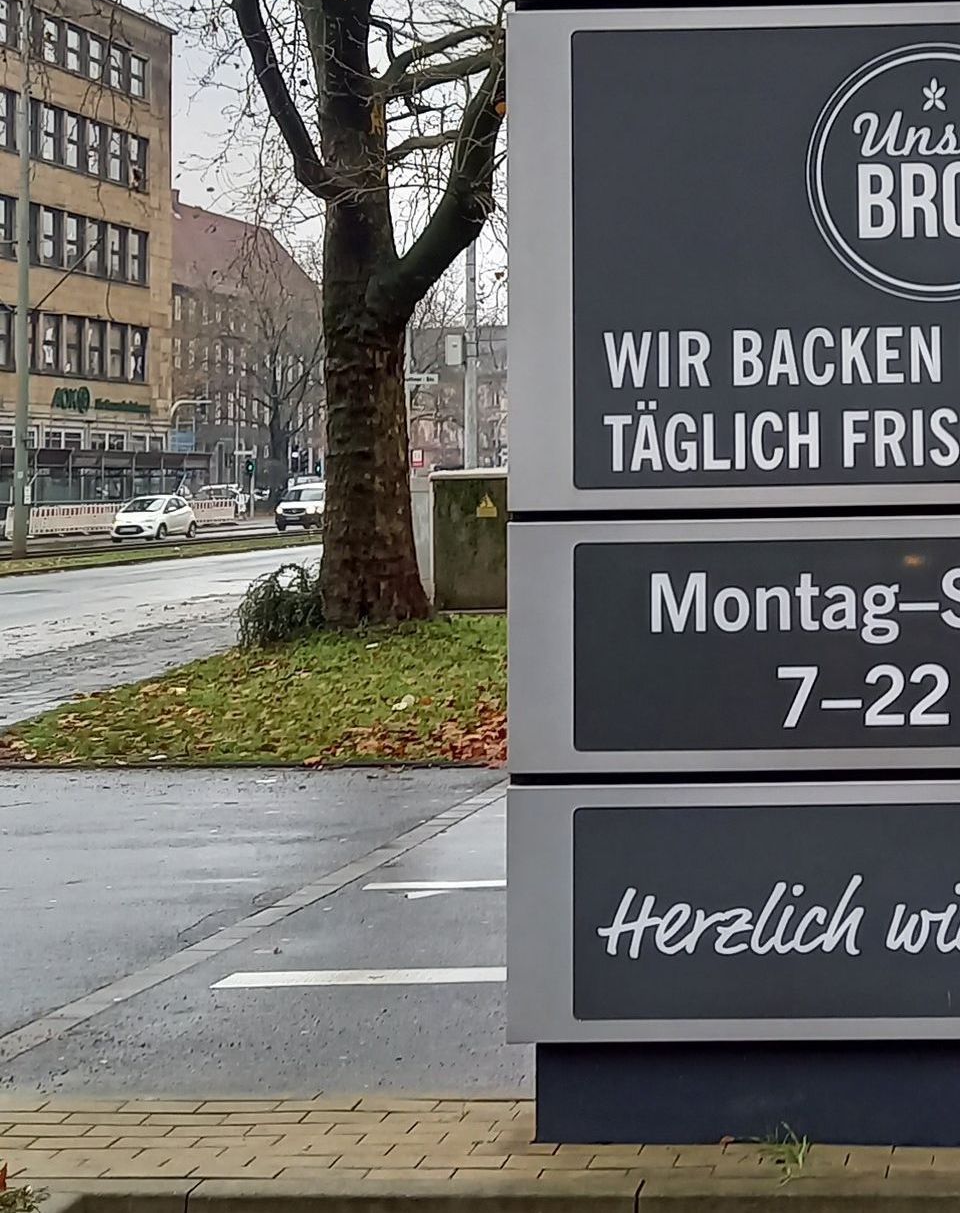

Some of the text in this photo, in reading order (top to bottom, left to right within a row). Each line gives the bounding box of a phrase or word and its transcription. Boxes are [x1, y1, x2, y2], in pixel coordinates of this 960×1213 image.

[603, 330, 711, 389] WIR
[733, 326, 941, 386] BACKEN
[603, 400, 820, 472] TÄGLICH
[597, 874, 865, 959] Herzlich
